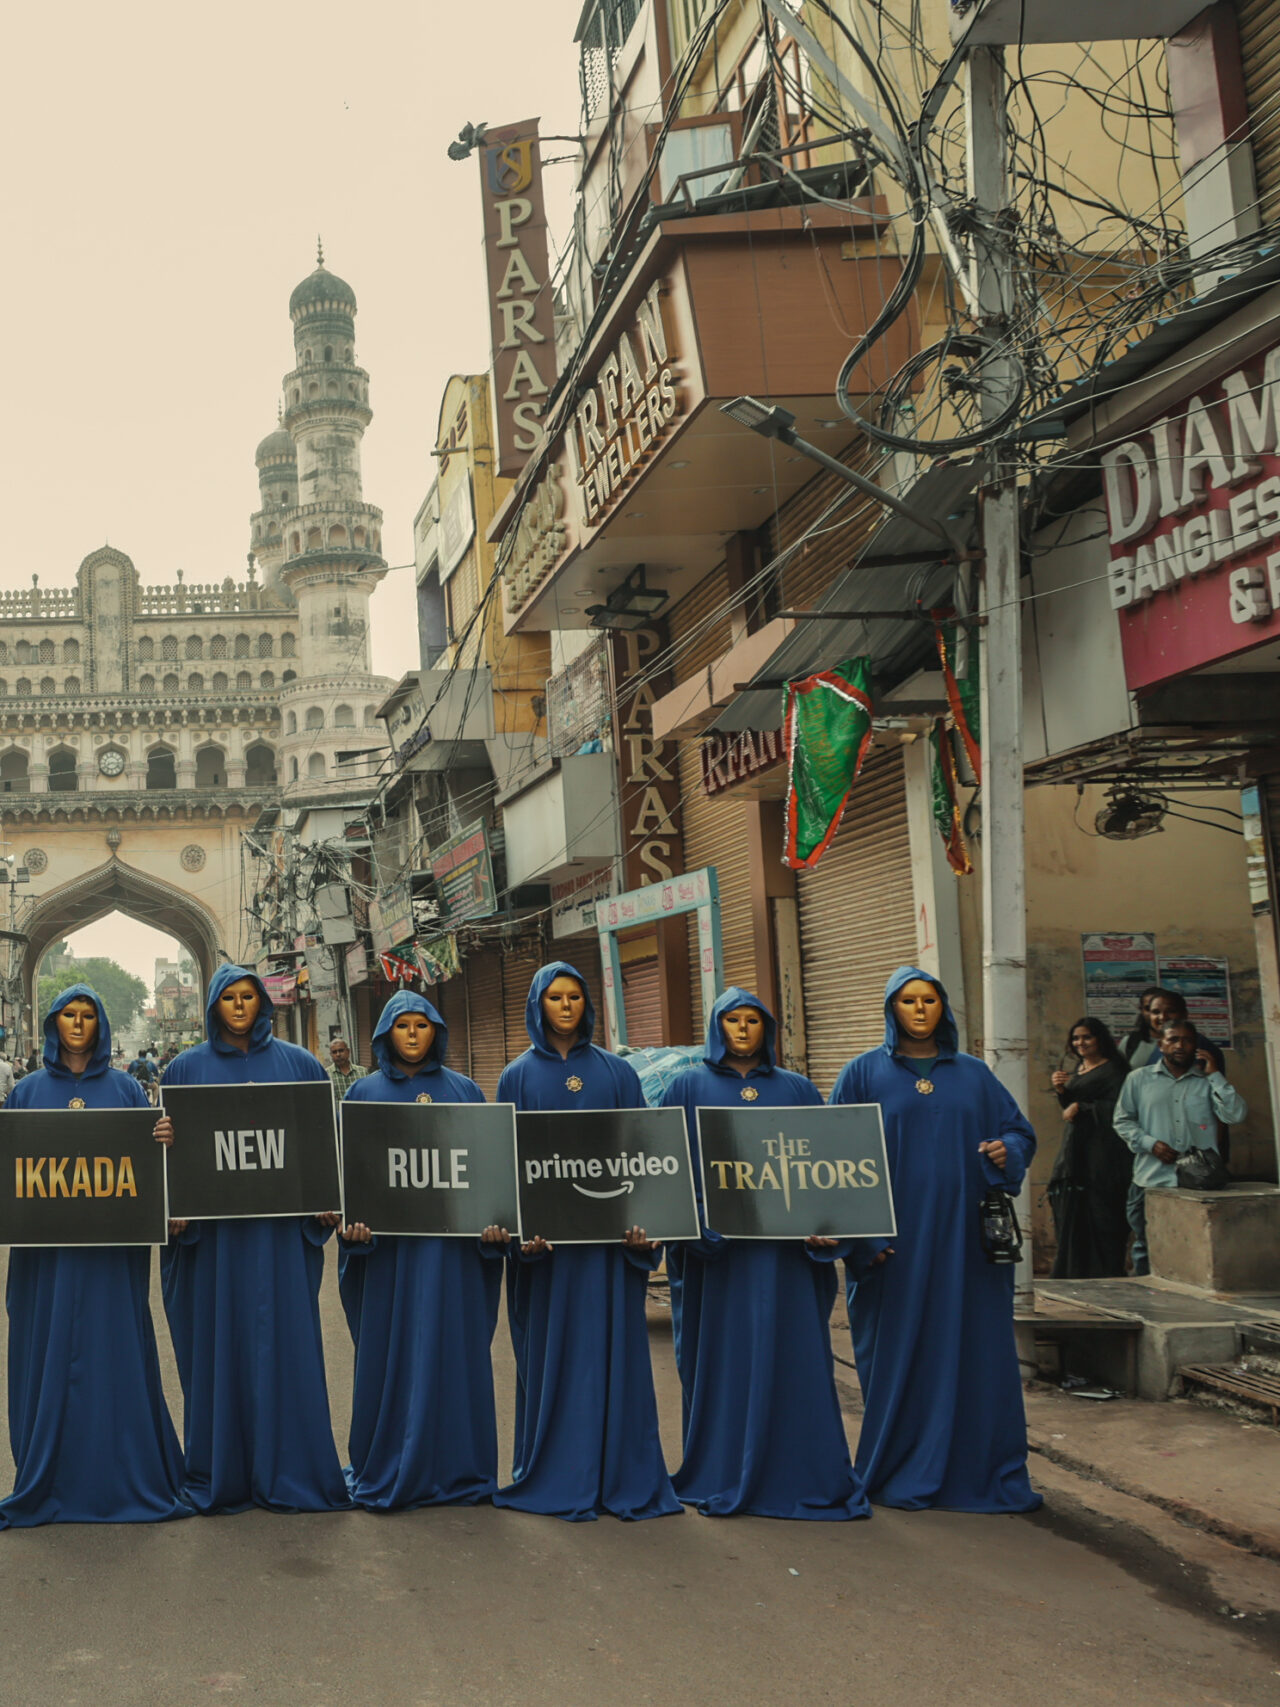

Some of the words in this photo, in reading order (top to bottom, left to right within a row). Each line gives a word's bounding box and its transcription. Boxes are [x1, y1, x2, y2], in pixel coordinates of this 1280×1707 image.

[494, 198, 548, 451] PARAS
[567, 278, 668, 484] IRFAN
[582, 366, 677, 529] JEWELLERS
[1107, 475, 1280, 610] BANGLES
[1229, 566, 1265, 624] &
[621, 628, 678, 887] PARAS
[214, 1129, 285, 1171] NEW
[388, 1148, 470, 1189] RULE
[525, 1153, 603, 1184] prime
[606, 1151, 679, 1177] video
[762, 1136, 811, 1157] THE
[15, 1156, 138, 1198] IKKADA
[710, 1158, 880, 1191] TRAITORS
